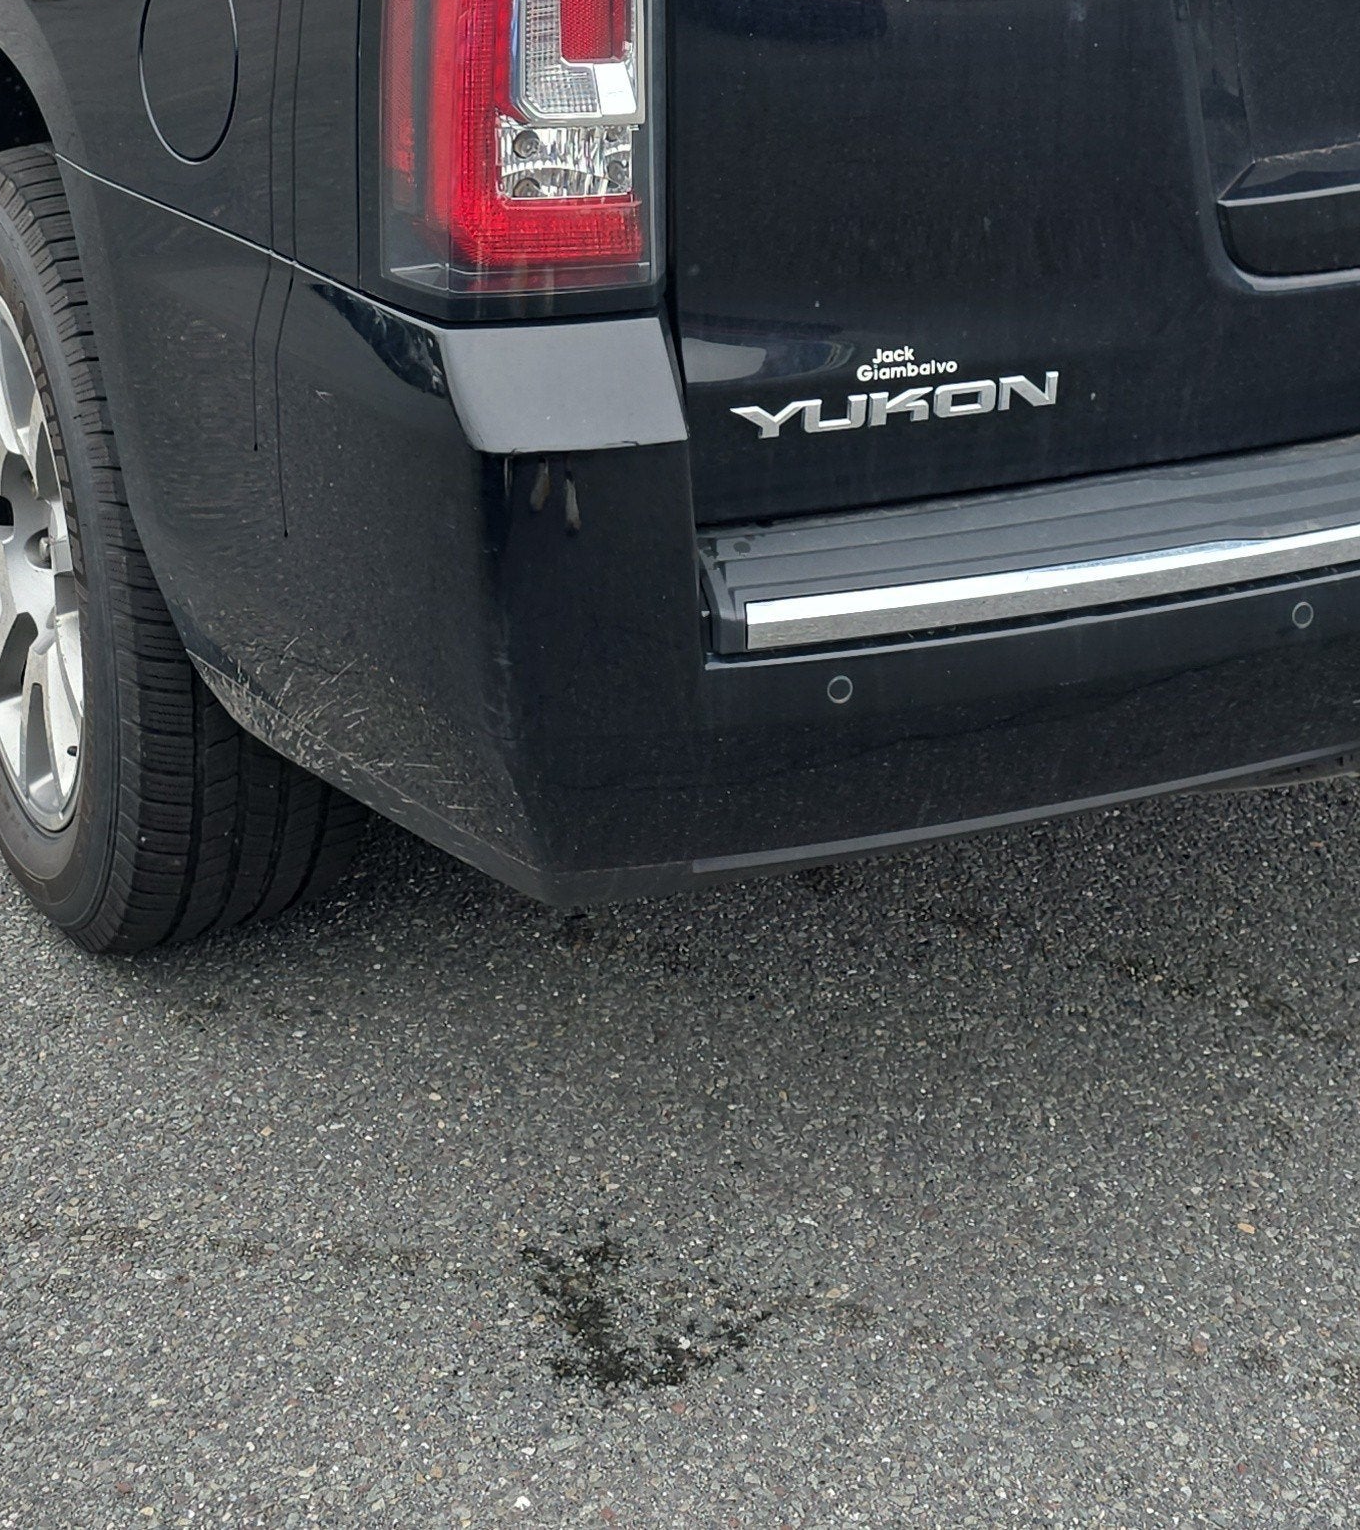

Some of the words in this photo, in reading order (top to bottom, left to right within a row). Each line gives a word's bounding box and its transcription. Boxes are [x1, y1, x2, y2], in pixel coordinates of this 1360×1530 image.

[856, 359, 958, 382] Giambalvo
[872, 345, 915, 364] Jack
[730, 371, 1059, 439] YUKON
[24, 332, 86, 576] MICHELIN
